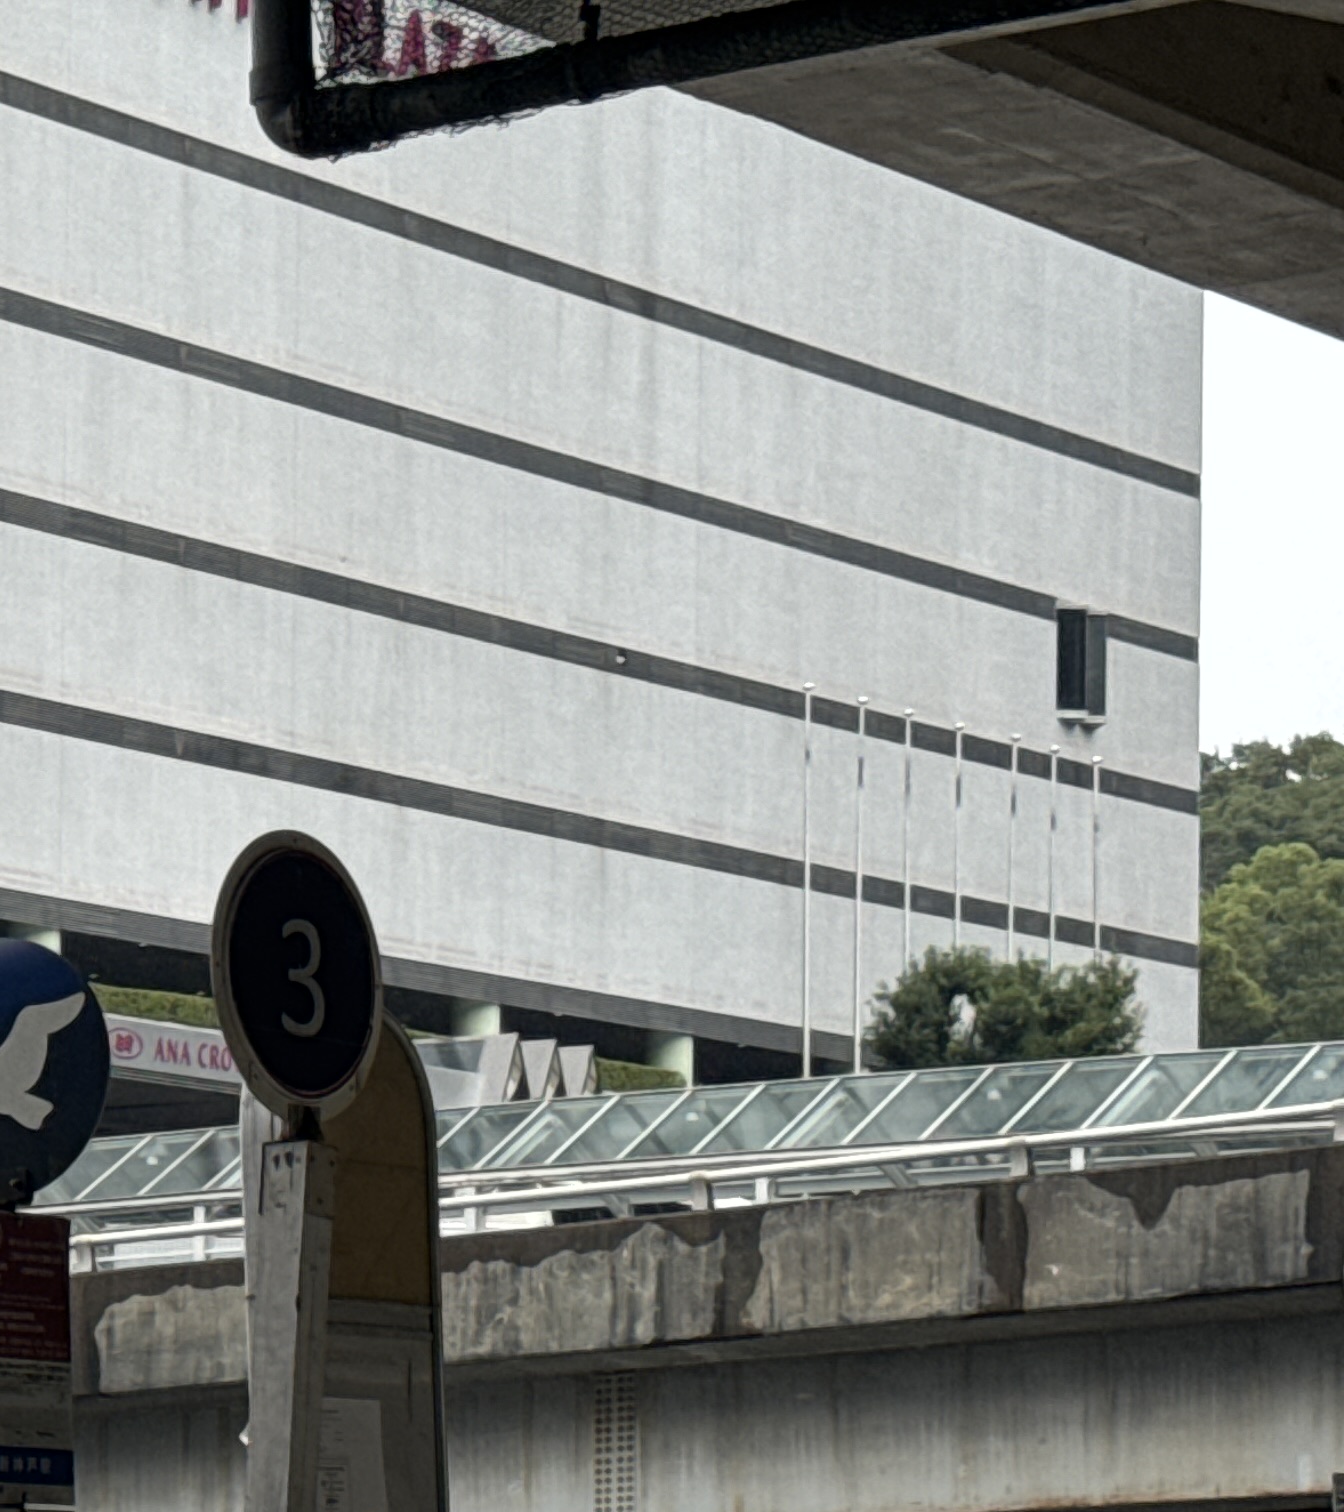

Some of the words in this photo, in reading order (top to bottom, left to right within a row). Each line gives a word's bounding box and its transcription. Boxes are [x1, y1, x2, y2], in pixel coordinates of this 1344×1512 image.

[280, 918, 326, 1037] 3
[154, 1036, 192, 1066] ANA
[198, 1042, 238, 1073] CRO
